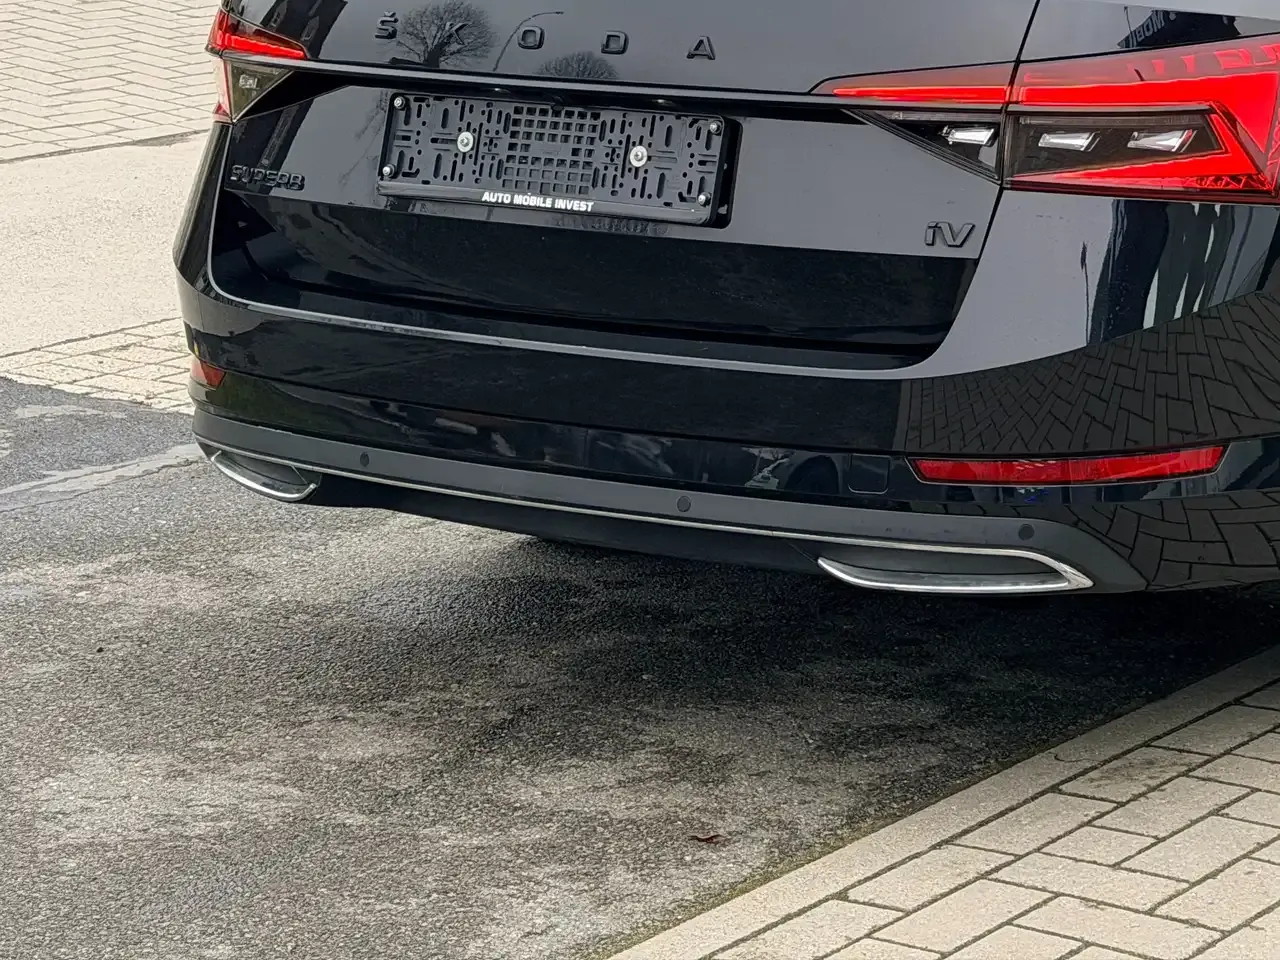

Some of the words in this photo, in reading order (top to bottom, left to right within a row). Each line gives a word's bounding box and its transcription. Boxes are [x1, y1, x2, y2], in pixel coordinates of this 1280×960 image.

[229, 164, 305, 190] SUPERB
[482, 191, 512, 204] AUTO
[513, 194, 552, 208] MOBILE
[555, 198, 594, 212] INVEST
[925, 221, 976, 248] iV
